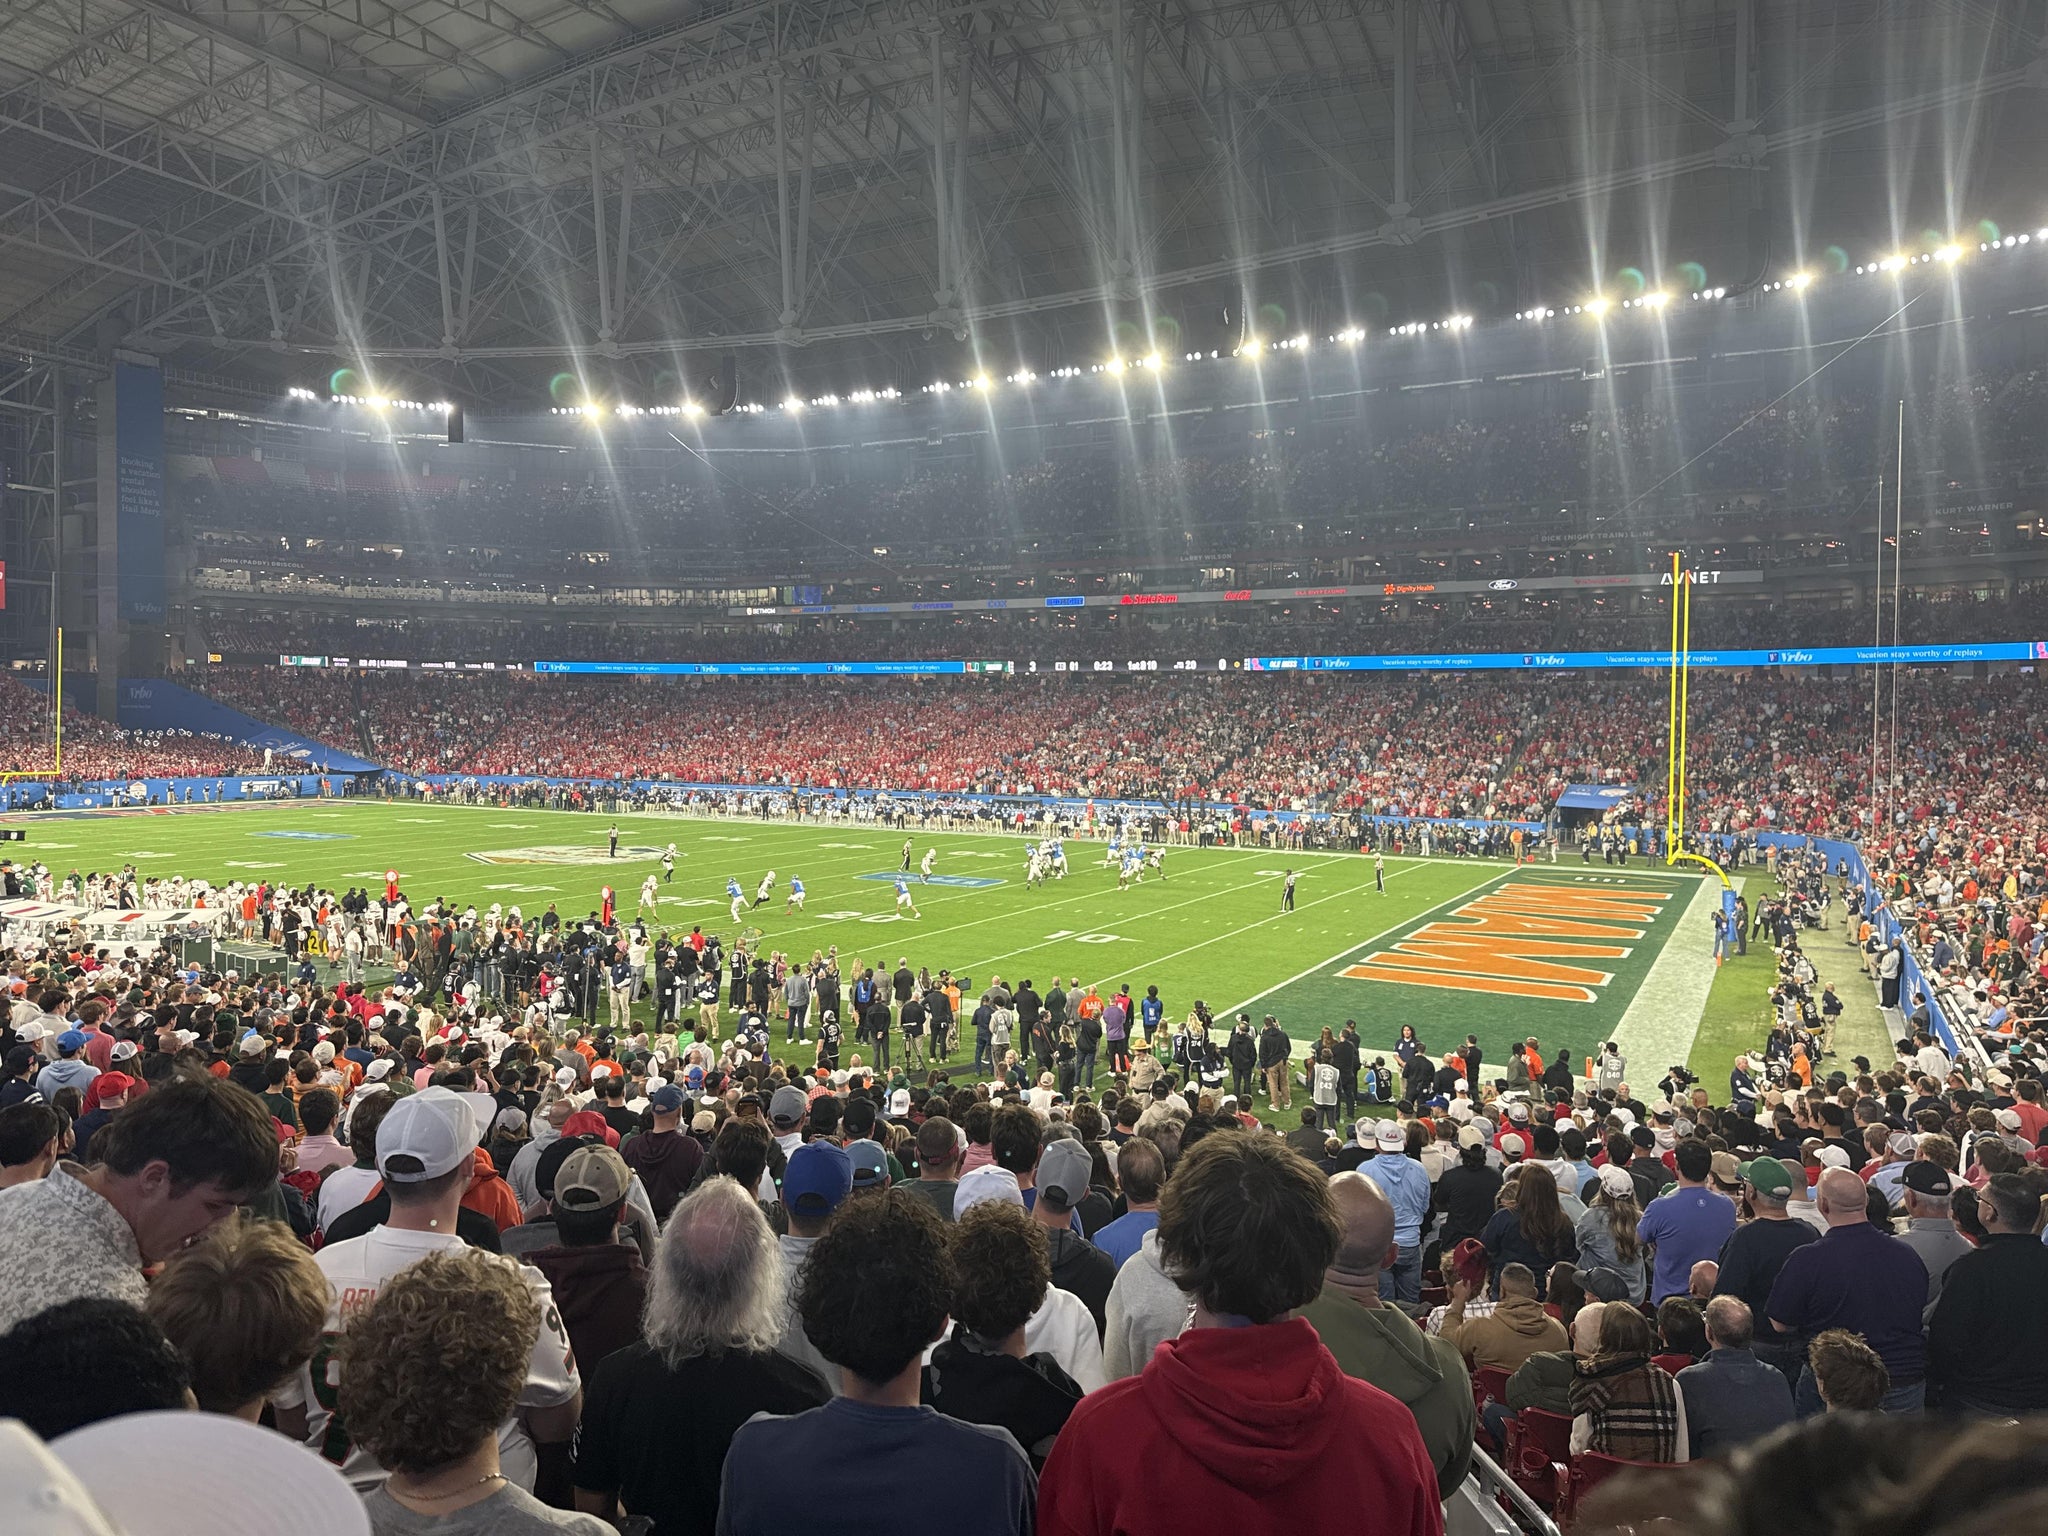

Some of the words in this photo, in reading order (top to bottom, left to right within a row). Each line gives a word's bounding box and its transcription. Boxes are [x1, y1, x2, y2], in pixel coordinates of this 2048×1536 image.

[1935, 507, 1963, 515] KURT
[1967, 502, 2013, 512] WARNER
[271, 561, 305, 569] DRISCOLL
[1781, 651, 1815, 662] Vrbo
[1856, 651, 1889, 659] Vacation
[1890, 651, 1910, 659] stays
[1912, 650, 1940, 658] worthy
[1953, 648, 1983, 657] replays
[1324, 658, 1350, 667] Vrbo
[1451, 658, 1473, 666] replays
[1535, 655, 1566, 665] Vrbo
[1656, 655, 1681, 663] worty
[1692, 655, 1718, 663] replays
[1029, 660, 1037, 672] 3
[1185, 660, 1197, 670] 20
[1043, 930, 1121, 944] 10
[310, 935, 318, 950] 2
